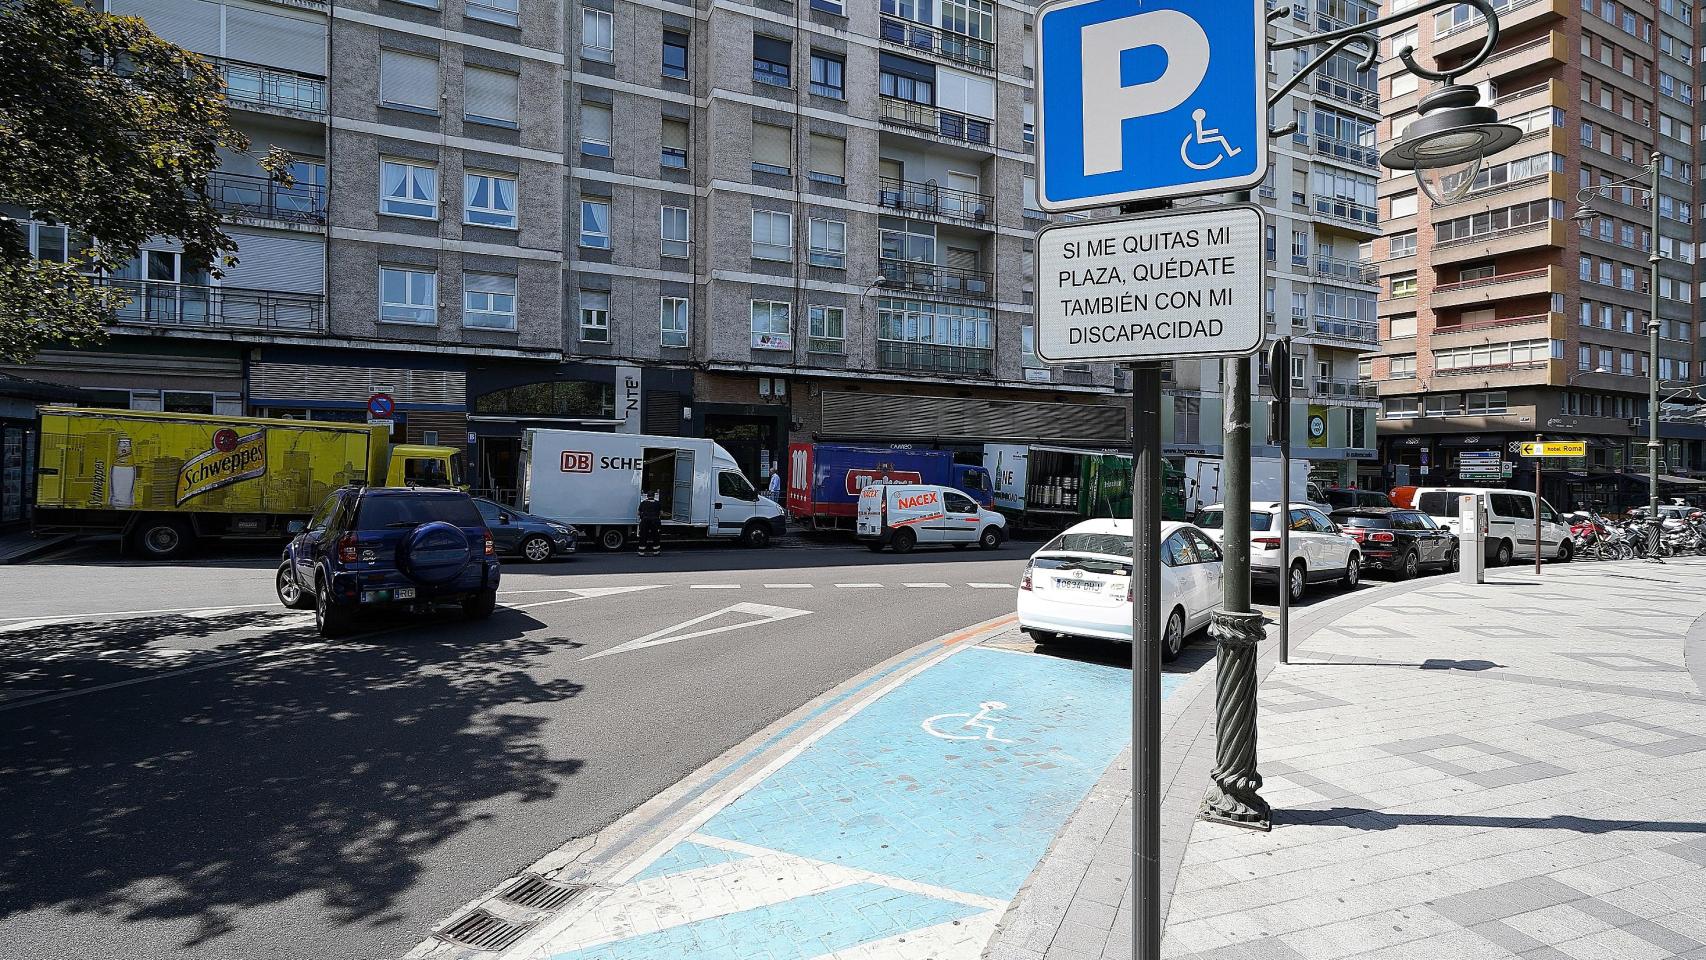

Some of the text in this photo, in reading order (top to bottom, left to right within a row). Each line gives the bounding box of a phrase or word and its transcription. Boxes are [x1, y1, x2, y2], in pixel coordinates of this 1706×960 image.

[1081, 9, 1210, 176] P
[1063, 227, 1230, 259] SI ME QUITAS MI
[1059, 256, 1235, 287] PLAZA, QUÉDATE
[1061, 288, 1232, 316] TAMBIÉN CON MI
[1070, 319, 1223, 345] DISCAPACIDAD
[184, 442, 264, 490] Schweppes
[564, 454, 590, 470] DB
[600, 456, 643, 471] SCHE
[88, 457, 106, 508] Schweppes
[897, 490, 938, 510] NACEX
